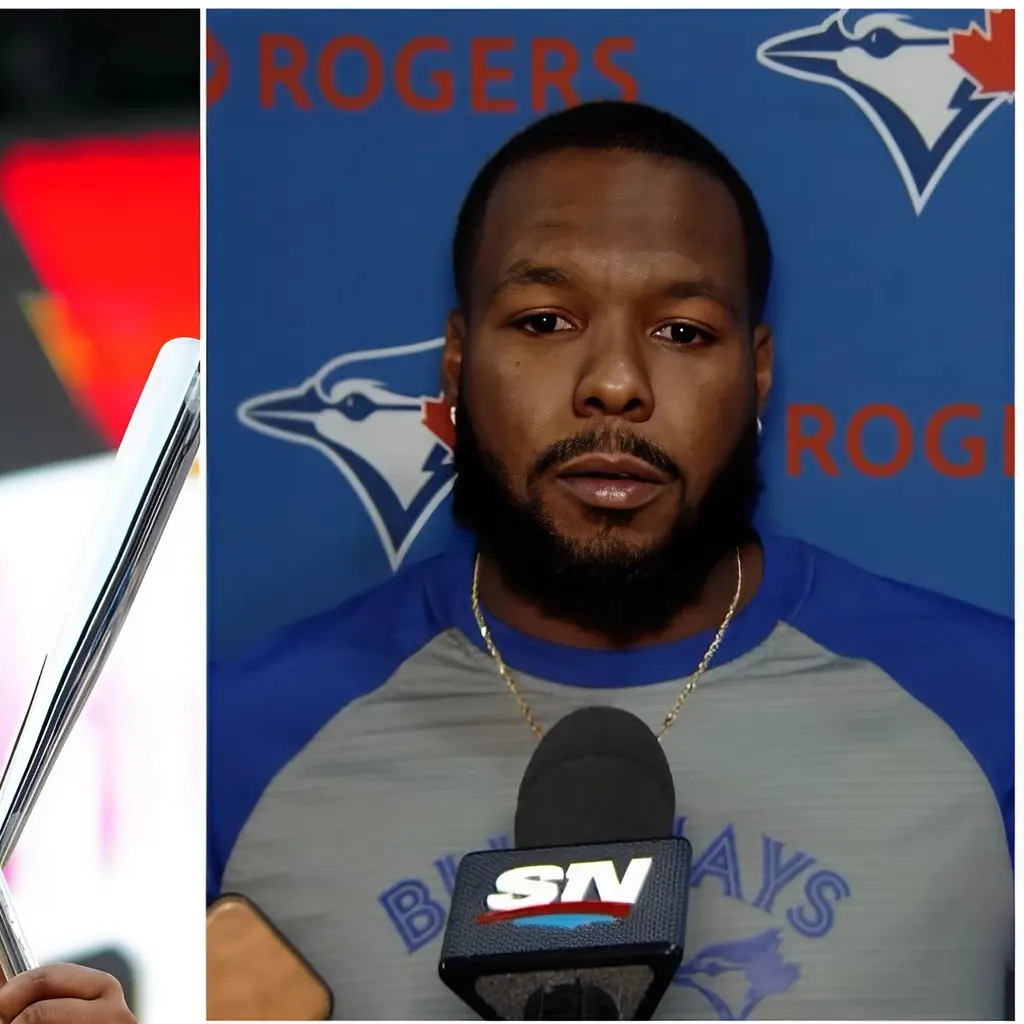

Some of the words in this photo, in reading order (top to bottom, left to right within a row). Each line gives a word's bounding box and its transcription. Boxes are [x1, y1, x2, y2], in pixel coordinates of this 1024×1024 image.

[258, 34, 641, 112] ROGERS
[486, 856, 653, 911] SN
[674, 814, 851, 939] AYS
